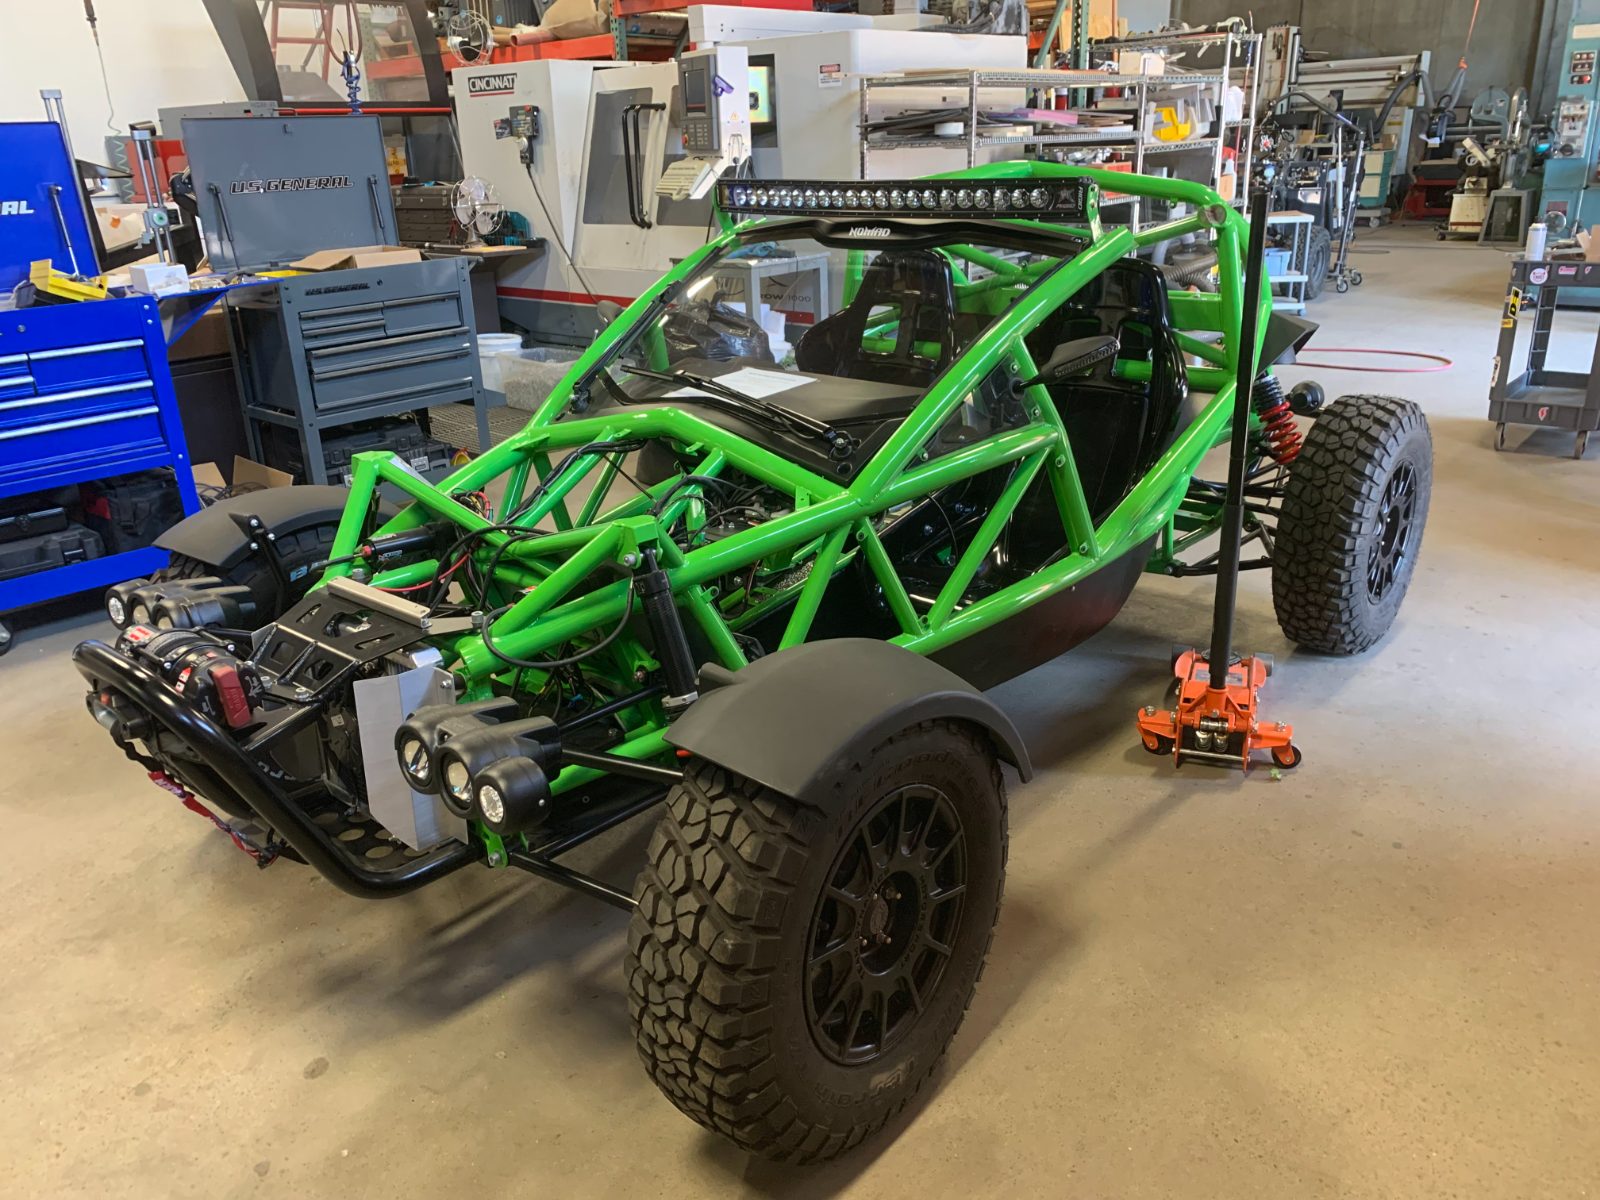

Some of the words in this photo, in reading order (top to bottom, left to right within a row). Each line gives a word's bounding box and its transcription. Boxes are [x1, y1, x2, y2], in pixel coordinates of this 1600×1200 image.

[265, 176, 354, 191] GENERAL
[0, 200, 34, 215] AL
[849, 226, 891, 238] NOMAD
